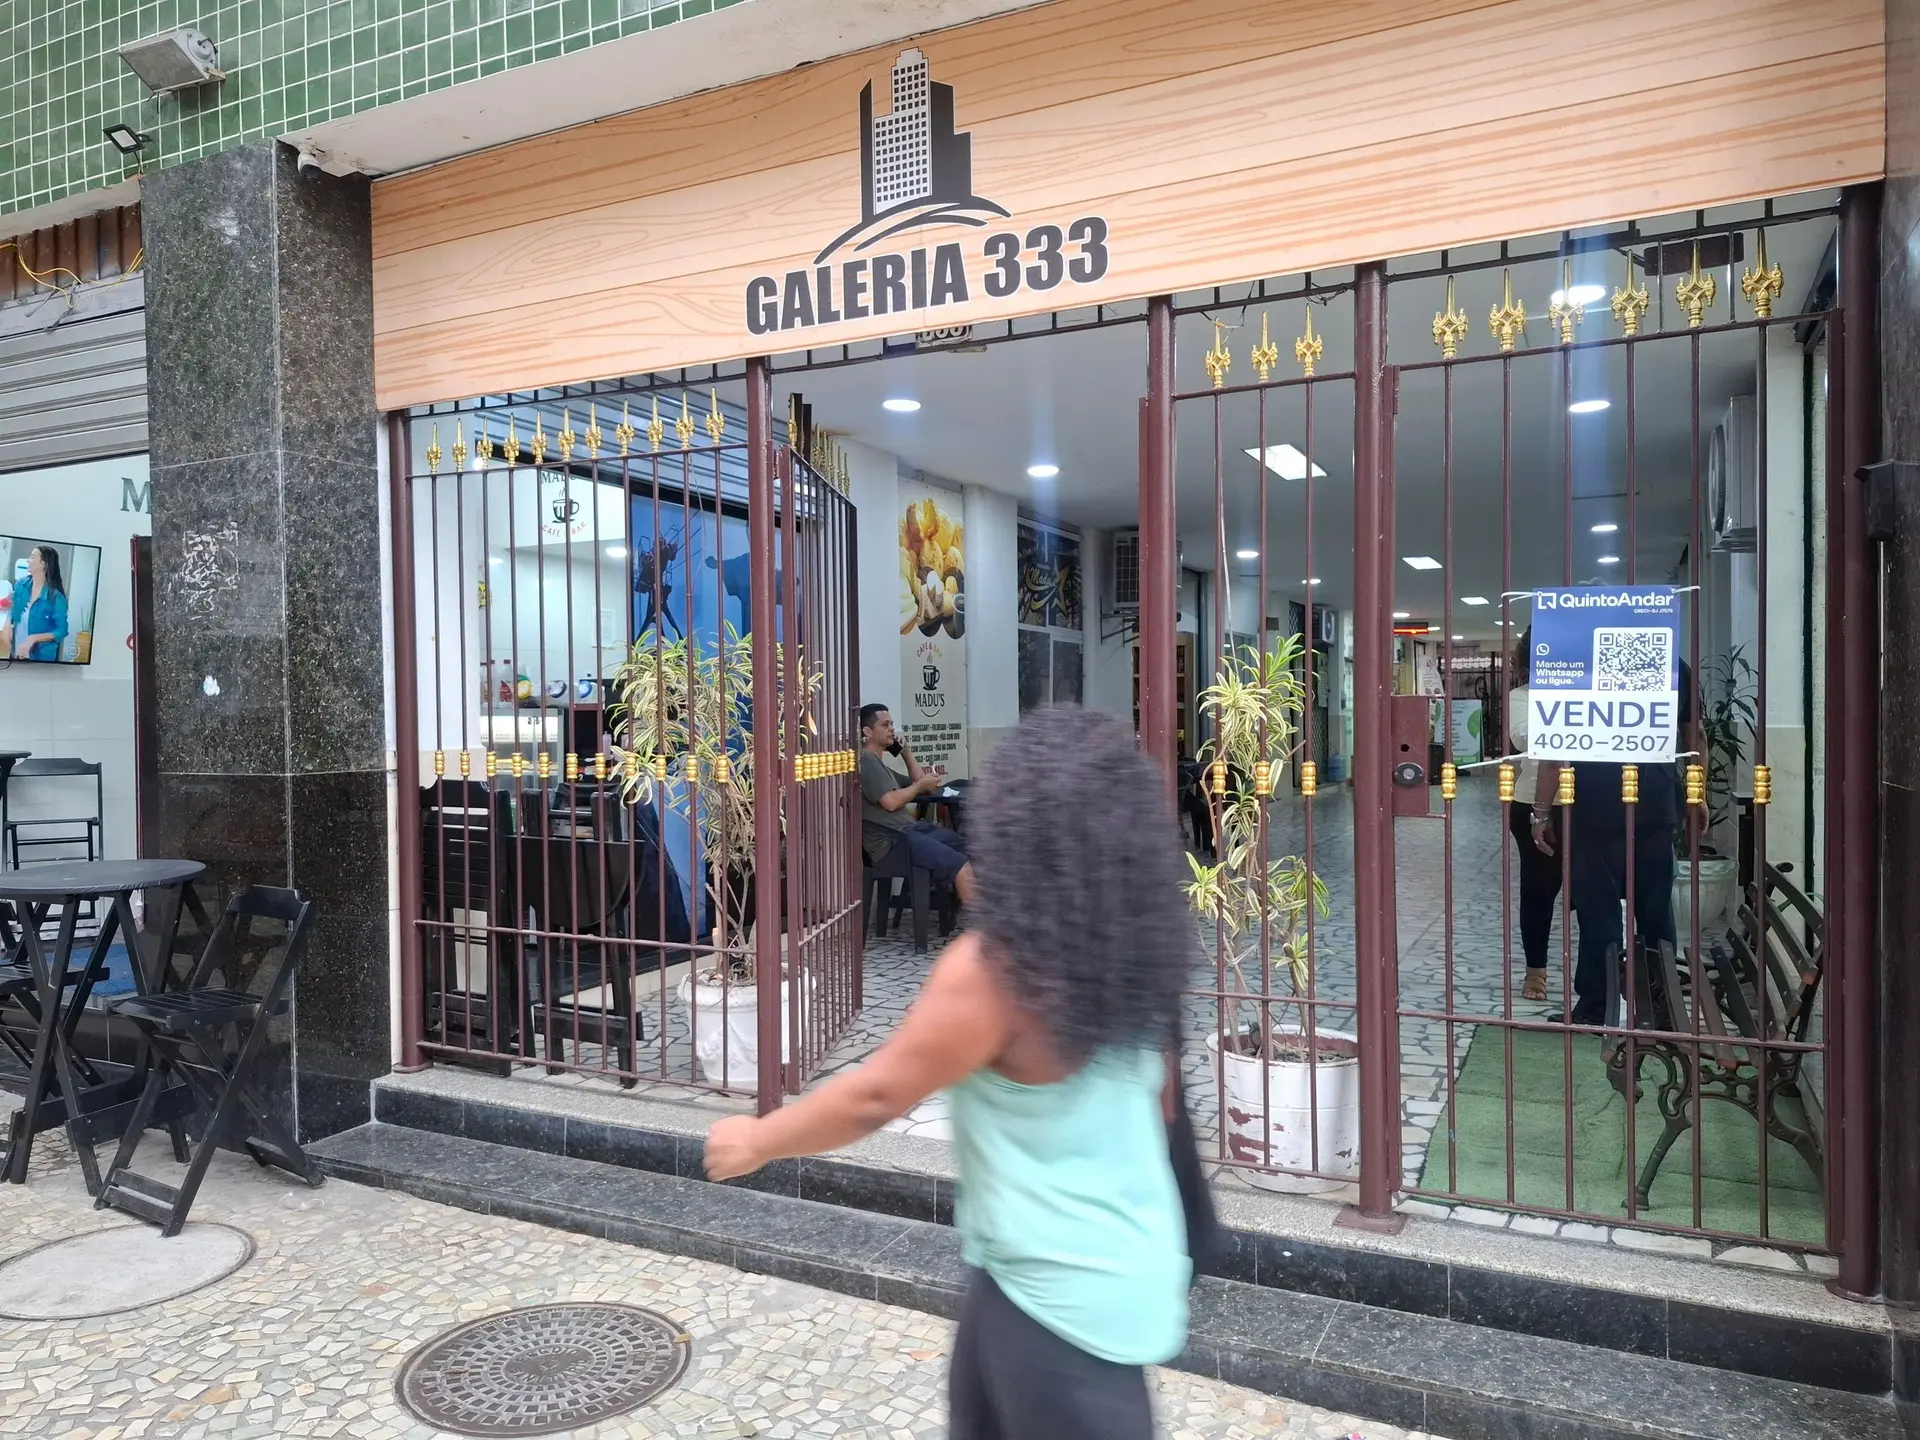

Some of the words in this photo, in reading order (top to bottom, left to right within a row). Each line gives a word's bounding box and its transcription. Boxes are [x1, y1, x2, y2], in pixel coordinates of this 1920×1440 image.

[746, 242, 969, 336] GALERIA
[983, 216, 1109, 298] 333
[571, 521, 587, 536] BAR
[1559, 591, 1674, 608] QuintoAndar
[1535, 660, 1568, 668] Mande
[1535, 668, 1585, 678] Whatsapp
[1549, 677, 1575, 687] ligue.
[914, 693, 945, 707] MADU'S
[1535, 700, 1670, 729] VENDE
[1533, 733, 1670, 752] 4020-2507
